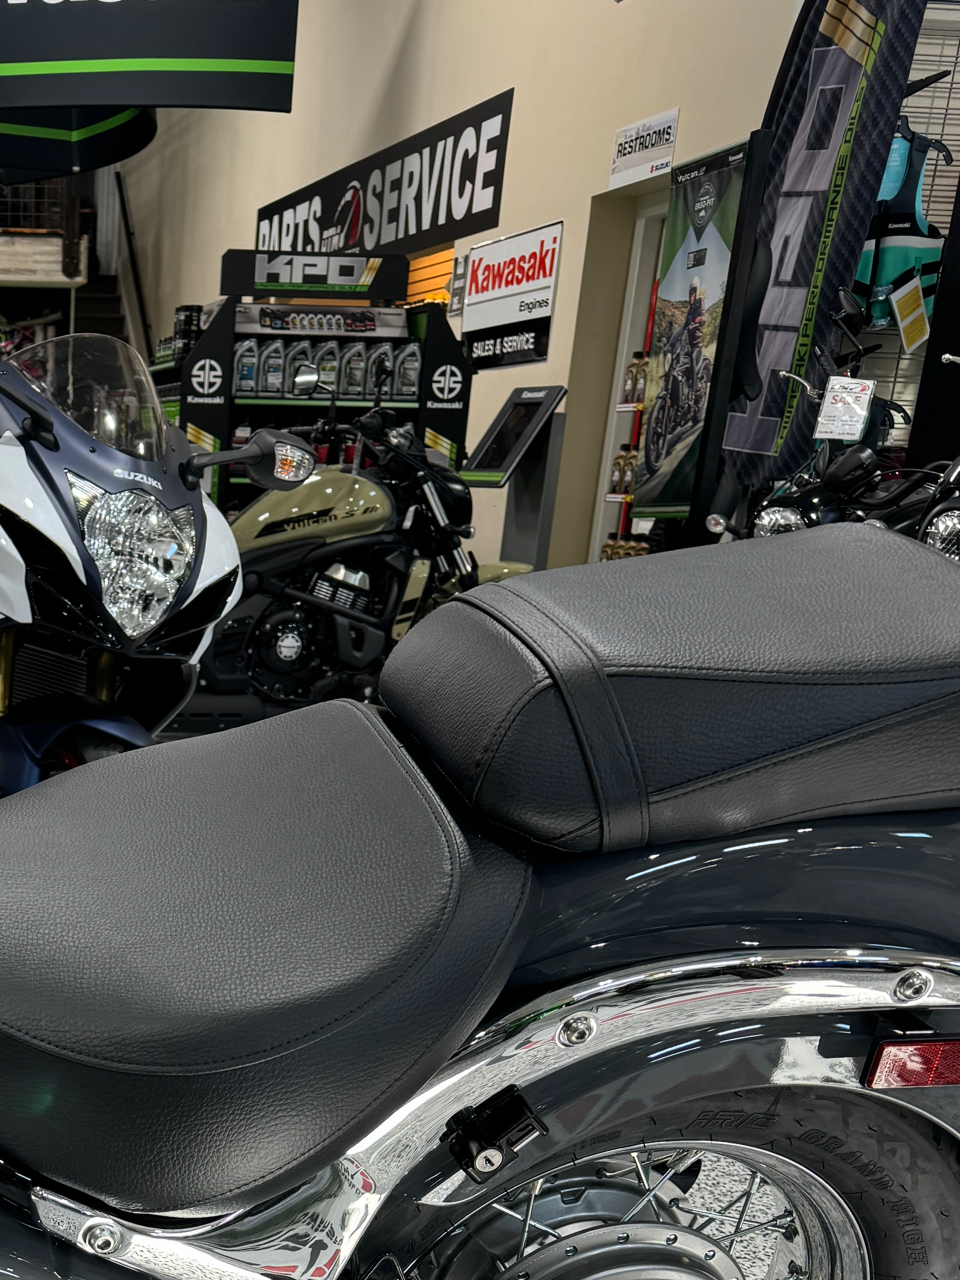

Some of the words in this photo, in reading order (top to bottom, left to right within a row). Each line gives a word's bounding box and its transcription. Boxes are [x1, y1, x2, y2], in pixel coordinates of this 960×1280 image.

[616, 125, 672, 159] RESTROOMS
[654, 160, 671, 171] SUZUKI
[677, 169, 698, 183] Vulcan
[257, 195, 322, 252] PARTS
[363, 113, 503, 251] SERVICE
[802, 153, 851, 340] PERFORMANCE
[843, 82, 865, 146] OILS
[255, 253, 368, 285] KPO
[468, 235, 558, 297] Kawasaki
[518, 296, 550, 313] Engines
[472, 340, 495, 358] SALES
[494, 338, 502, 354] &
[502, 332, 536, 352] SERVICE
[187, 395, 225, 404] Kawasaki
[427, 401, 463, 409] Kawasaki
[113, 468, 163, 491] SUZUKI
[283, 513, 338, 533] Vulcan
[797, 1128, 896, 1192] GRAND
[889, 1196, 929, 1266] HIGH
